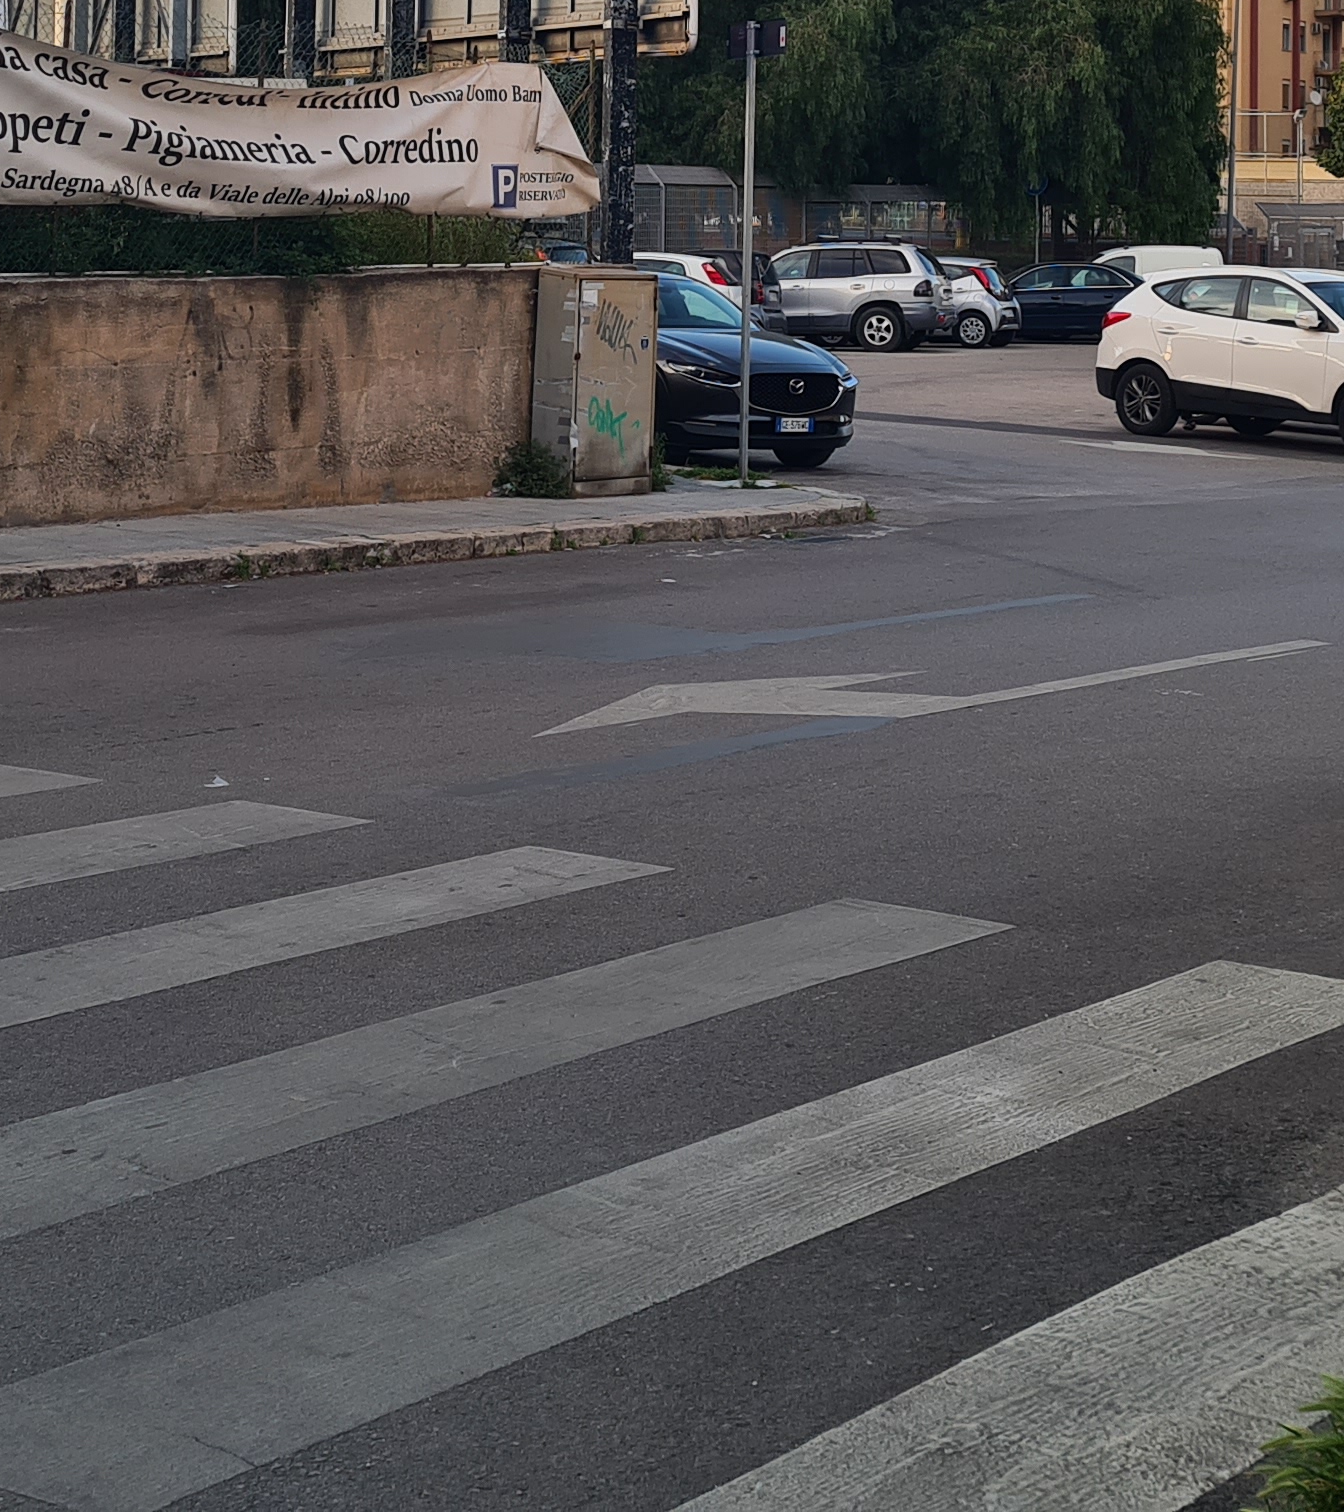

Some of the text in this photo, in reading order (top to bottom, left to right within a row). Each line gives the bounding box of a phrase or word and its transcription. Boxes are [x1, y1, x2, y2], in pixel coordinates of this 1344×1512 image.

[35, 51, 110, 90] casa
[409, 89, 463, 107] Donna
[467, 84, 508, 103] Uomo
[121, 117, 316, 166] Pigiameria
[338, 128, 479, 165] Corredino
[1, 167, 105, 197] Sardegna
[161, 182, 171, 198] e
[176, 180, 202, 199] da
[209, 183, 259, 205] Viale
[262, 186, 310, 206] delle
